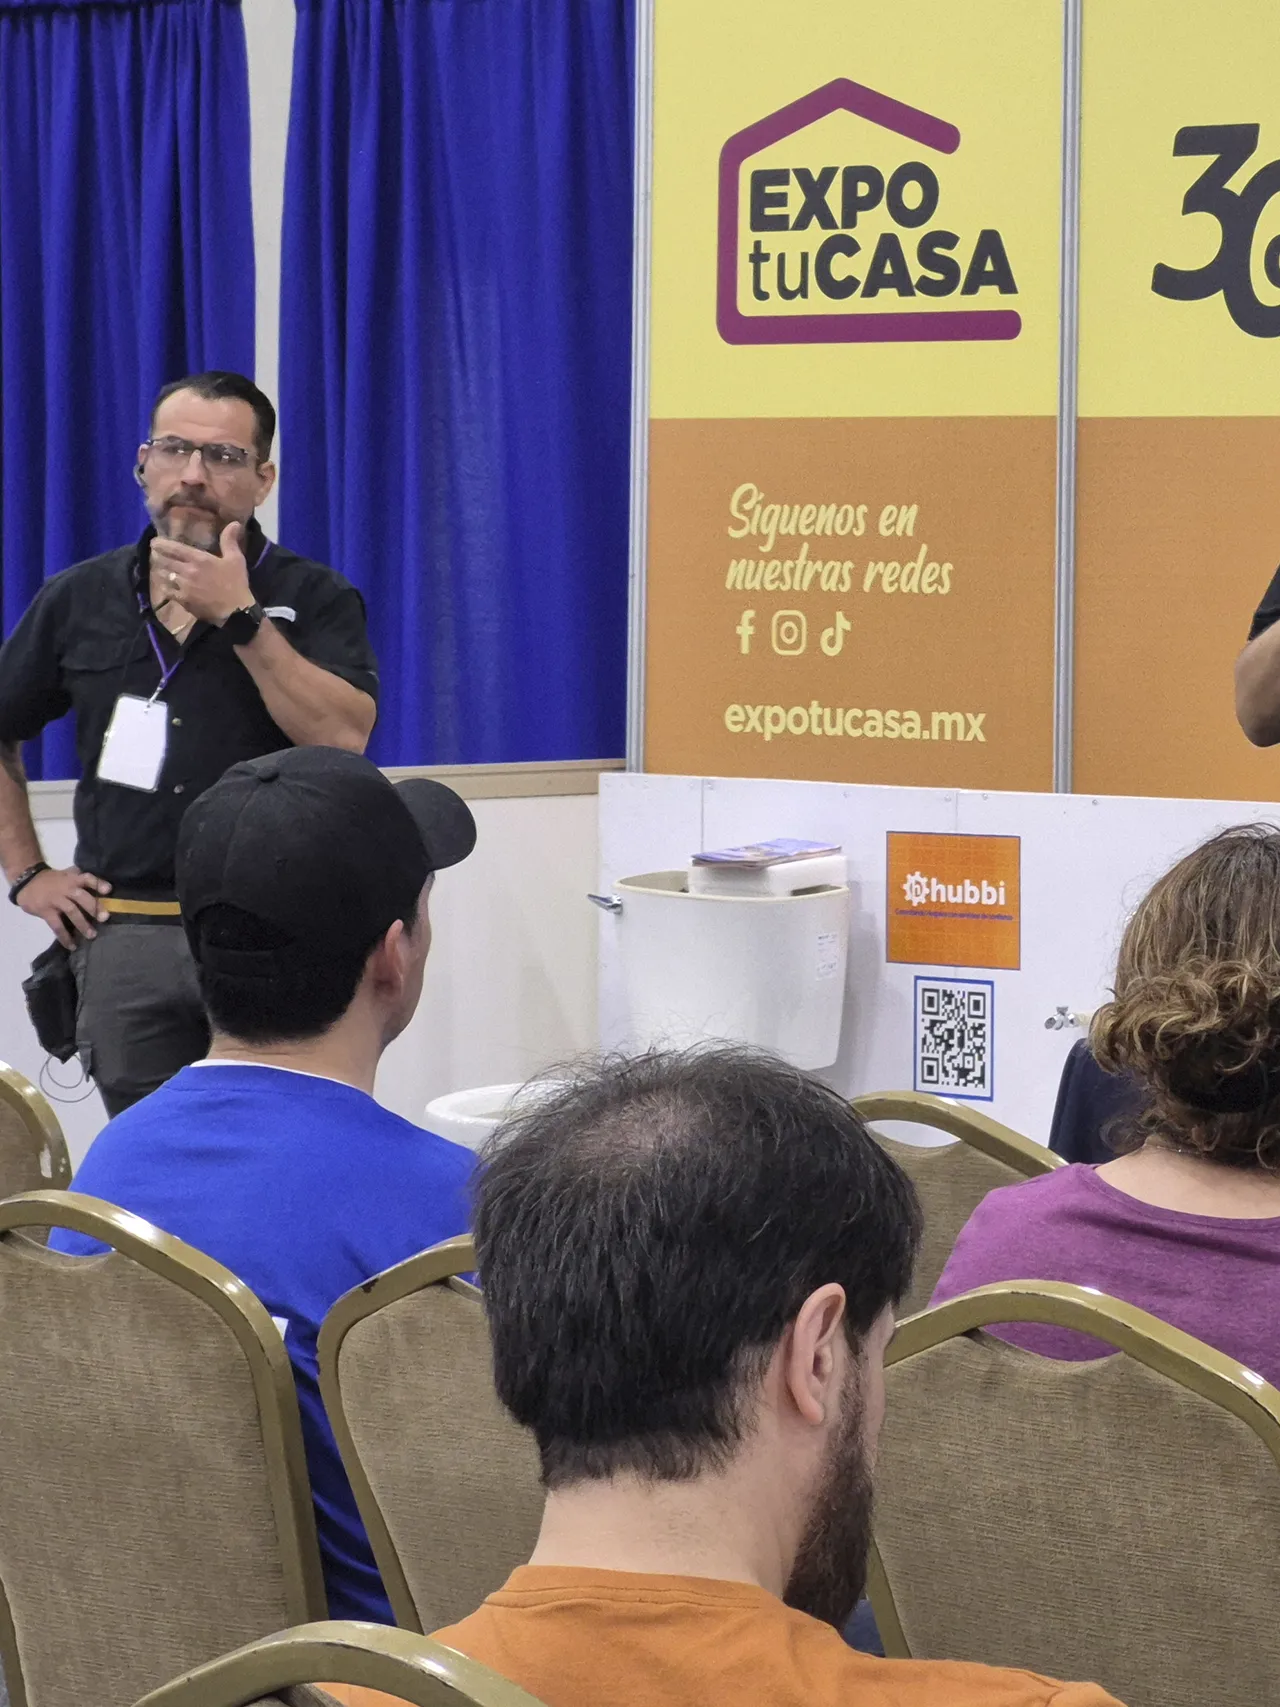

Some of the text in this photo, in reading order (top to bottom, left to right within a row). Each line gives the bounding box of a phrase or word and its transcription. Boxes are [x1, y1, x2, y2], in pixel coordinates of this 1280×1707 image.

[750, 161, 940, 232] EXPO
[749, 229, 1019, 301] tuCASA
[727, 483, 919, 552] Síguenos en
[725, 542, 954, 595] nuestras redes
[724, 700, 987, 742] expotucasa.mx
[930, 877, 1006, 906] hubbi
